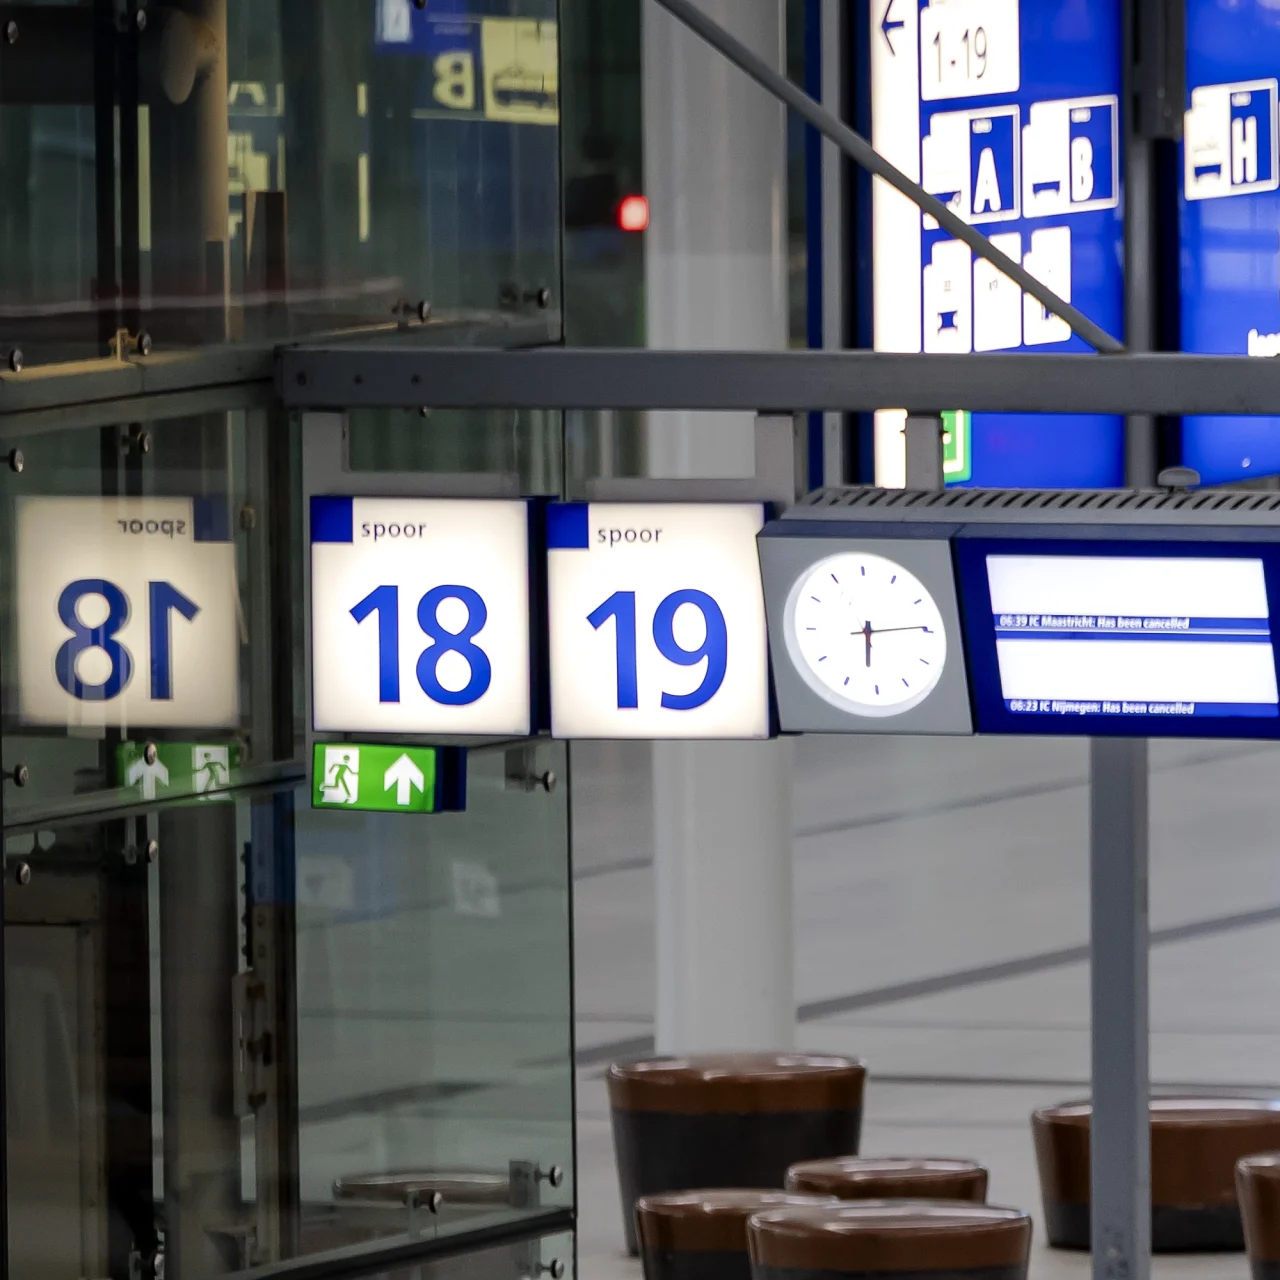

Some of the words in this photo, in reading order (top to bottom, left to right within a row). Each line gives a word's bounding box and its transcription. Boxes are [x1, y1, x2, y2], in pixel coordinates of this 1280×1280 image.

[973, 147, 1001, 214] A
[1071, 136, 1093, 202] B
[1232, 116, 1258, 185] H
[361, 521, 427, 539] spoor
[597, 526, 663, 544] spoor
[349, 585, 491, 706] 18
[586, 589, 727, 711] 19
[1097, 617, 1116, 629] Has
[1118, 617, 1142, 629] been
[1143, 617, 1190, 630] cancelled
[1103, 701, 1121, 713] Has
[1123, 702, 1147, 714] been
[1149, 702, 1195, 715] cancelled
